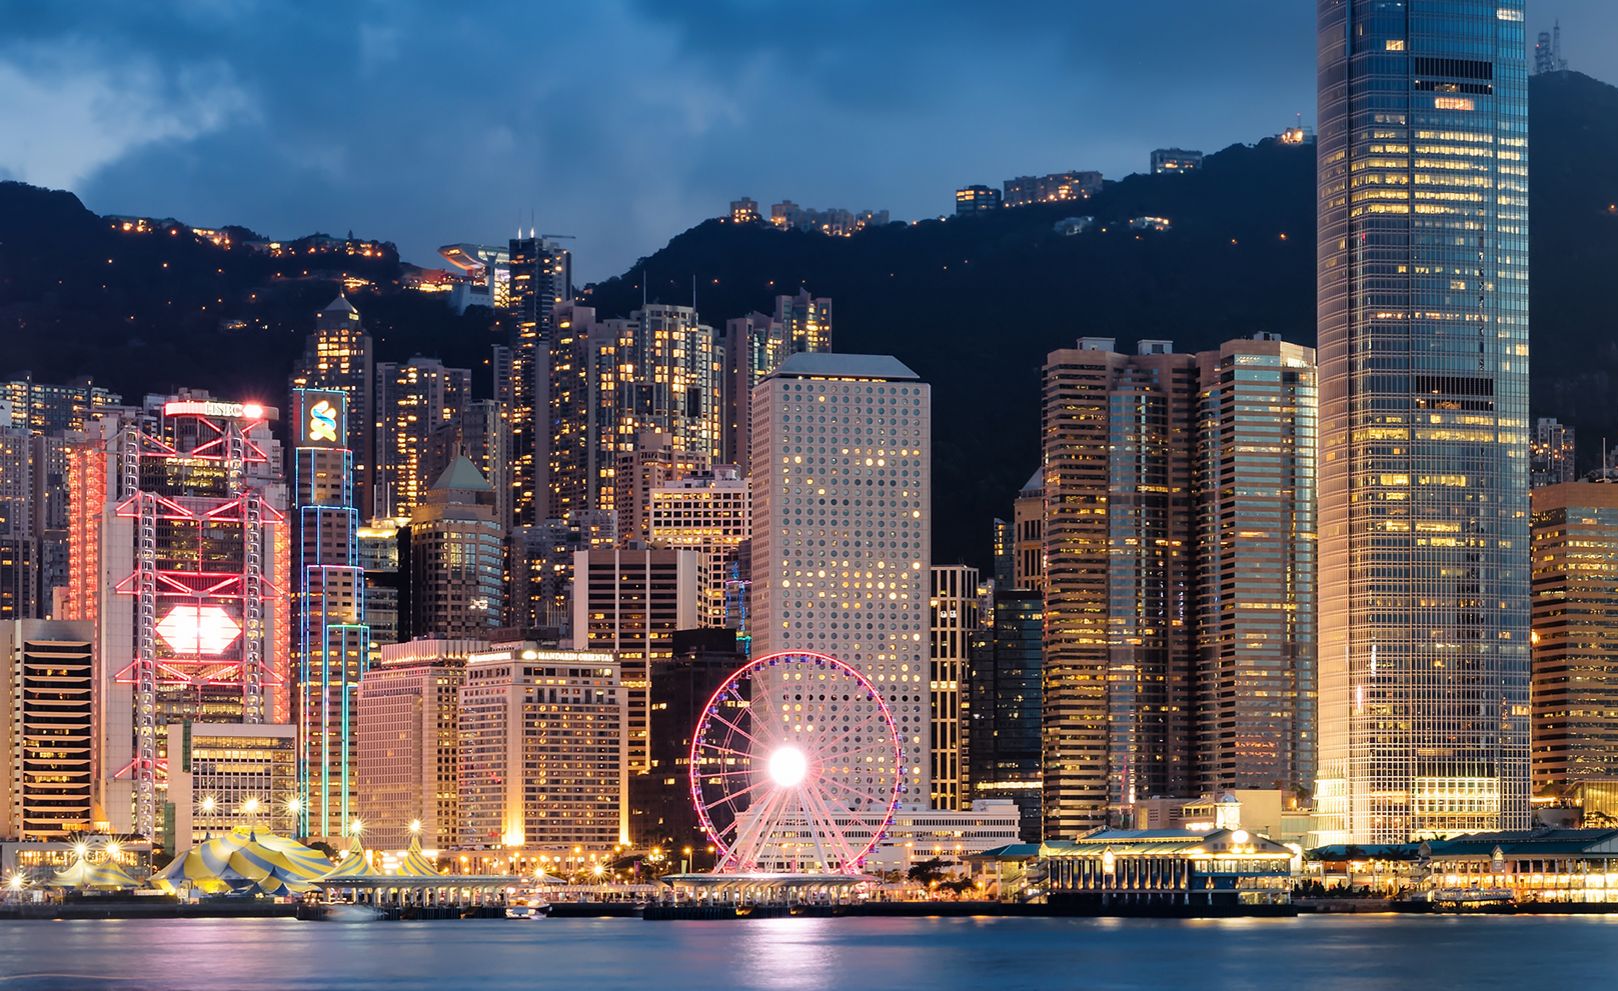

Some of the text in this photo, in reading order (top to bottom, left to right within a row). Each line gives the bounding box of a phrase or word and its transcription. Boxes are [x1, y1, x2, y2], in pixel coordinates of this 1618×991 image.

[206, 402, 242, 417] HSBC
[538, 652, 614, 662] MANDARIN ORIENTAL
